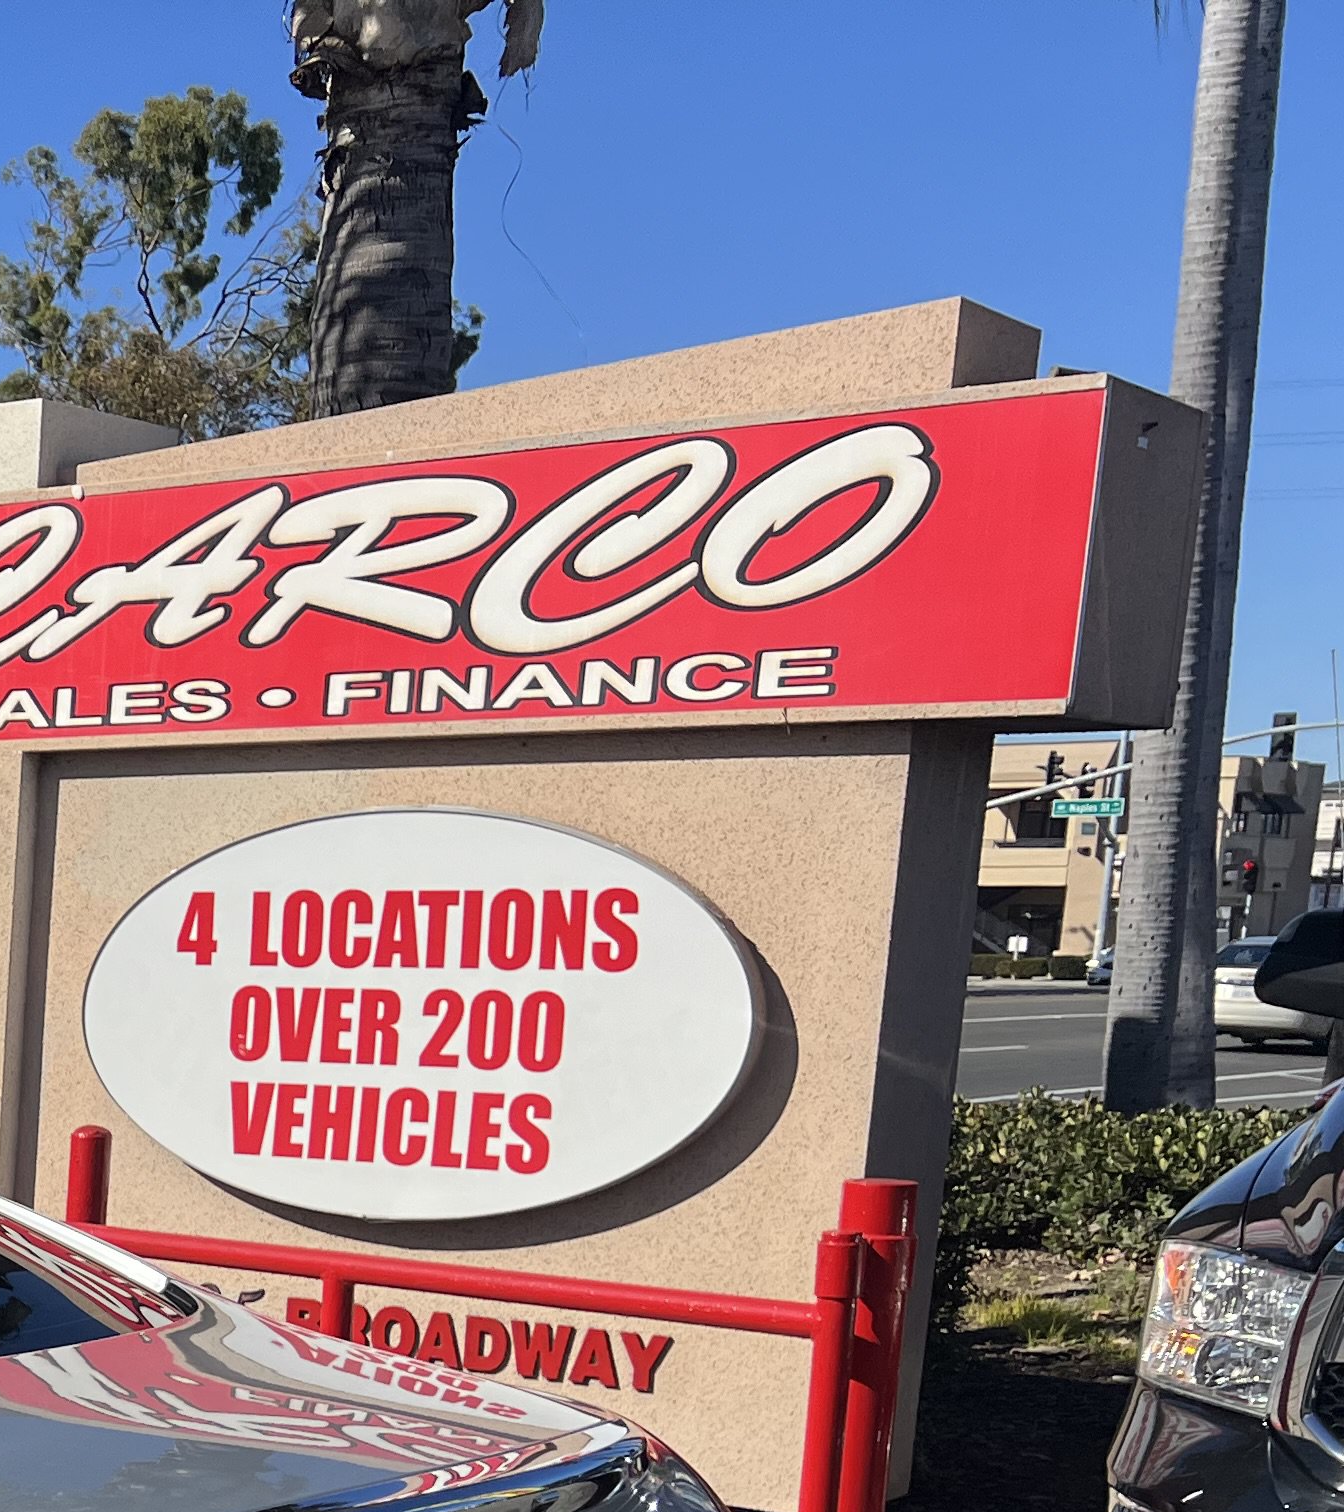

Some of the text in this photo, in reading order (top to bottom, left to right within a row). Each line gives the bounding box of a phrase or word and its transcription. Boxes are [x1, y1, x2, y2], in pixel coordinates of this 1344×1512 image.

[323, 646, 839, 718] FINANCE
[176, 887, 639, 973] 4 LOCATIONS
[229, 985, 566, 1073] OVER 200
[230, 1081, 553, 1175] VEHICLES
